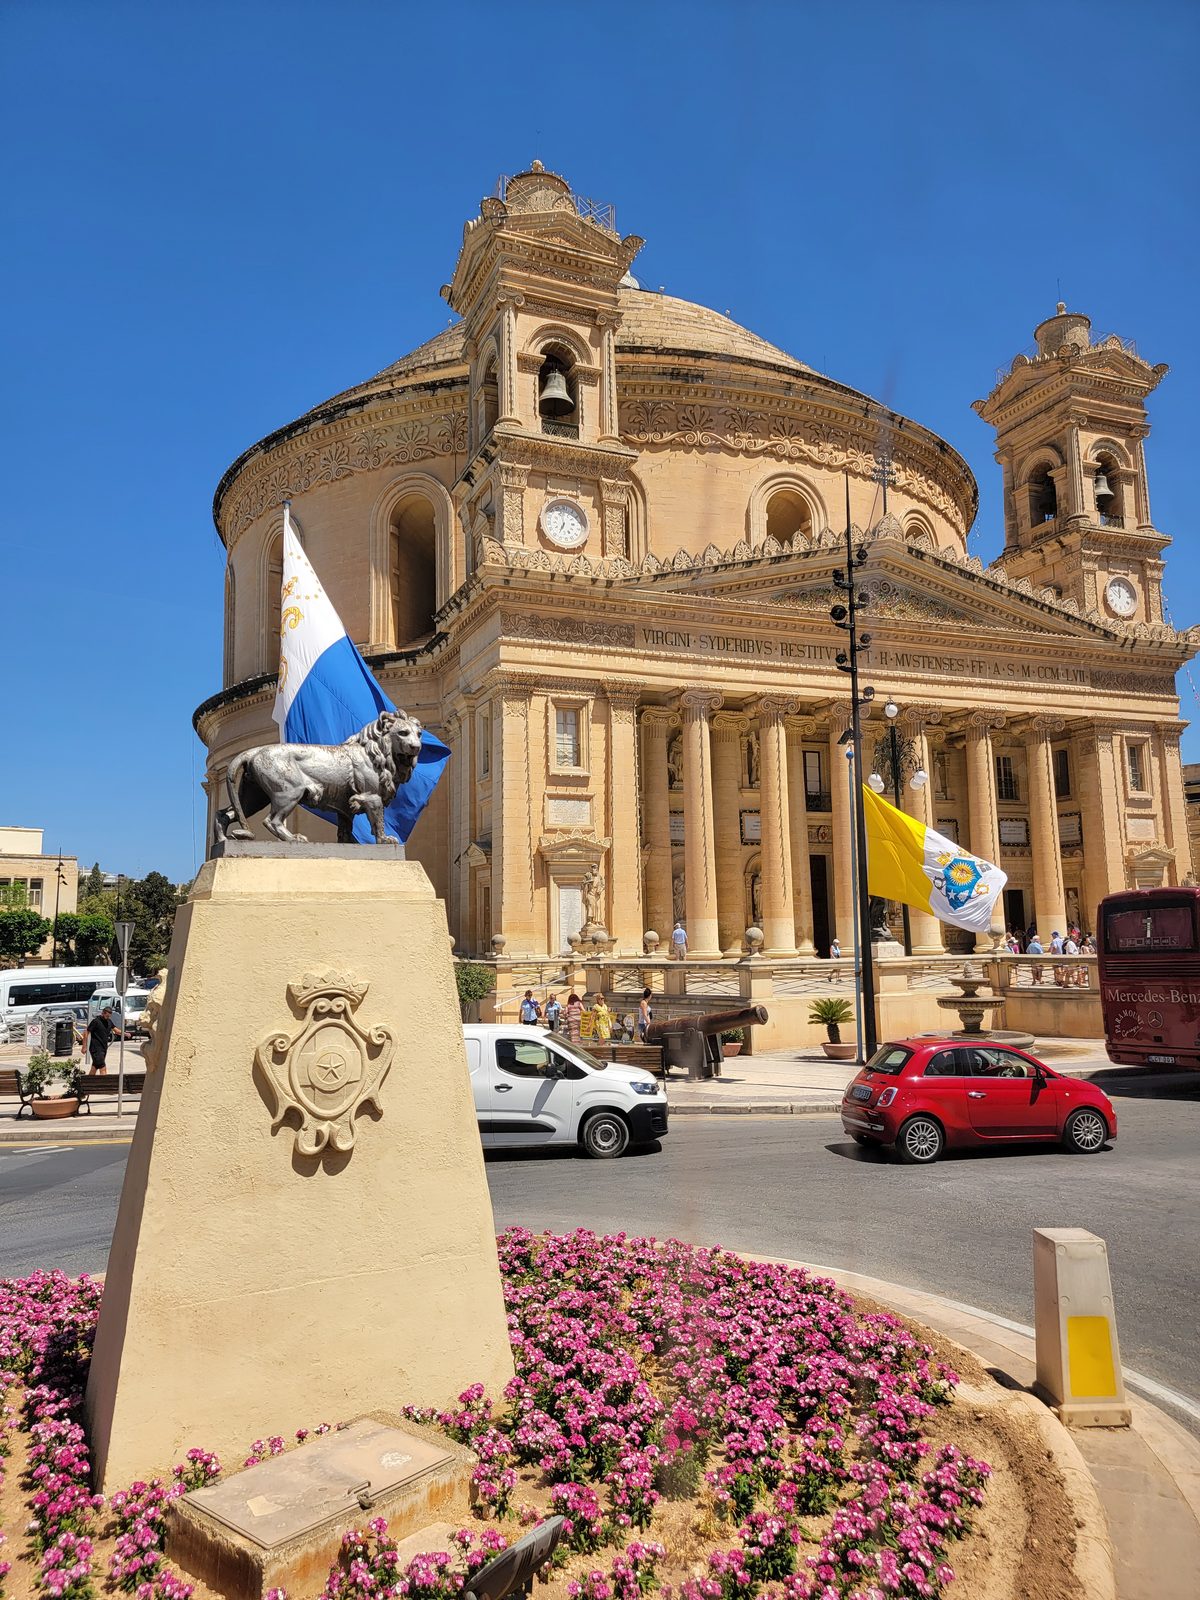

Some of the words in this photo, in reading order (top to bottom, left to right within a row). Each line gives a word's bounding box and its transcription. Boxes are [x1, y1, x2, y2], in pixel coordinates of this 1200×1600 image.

[642, 628, 691, 648] VIRGINI
[699, 635, 773, 656] SYDERIBVS
[879, 651, 888, 665] H
[895, 652, 965, 672] MVSTENSES
[971, 659, 986, 674] FF
[993, 661, 1001, 675] A
[1006, 663, 1015, 676] S
[1021, 664, 1031, 678] M
